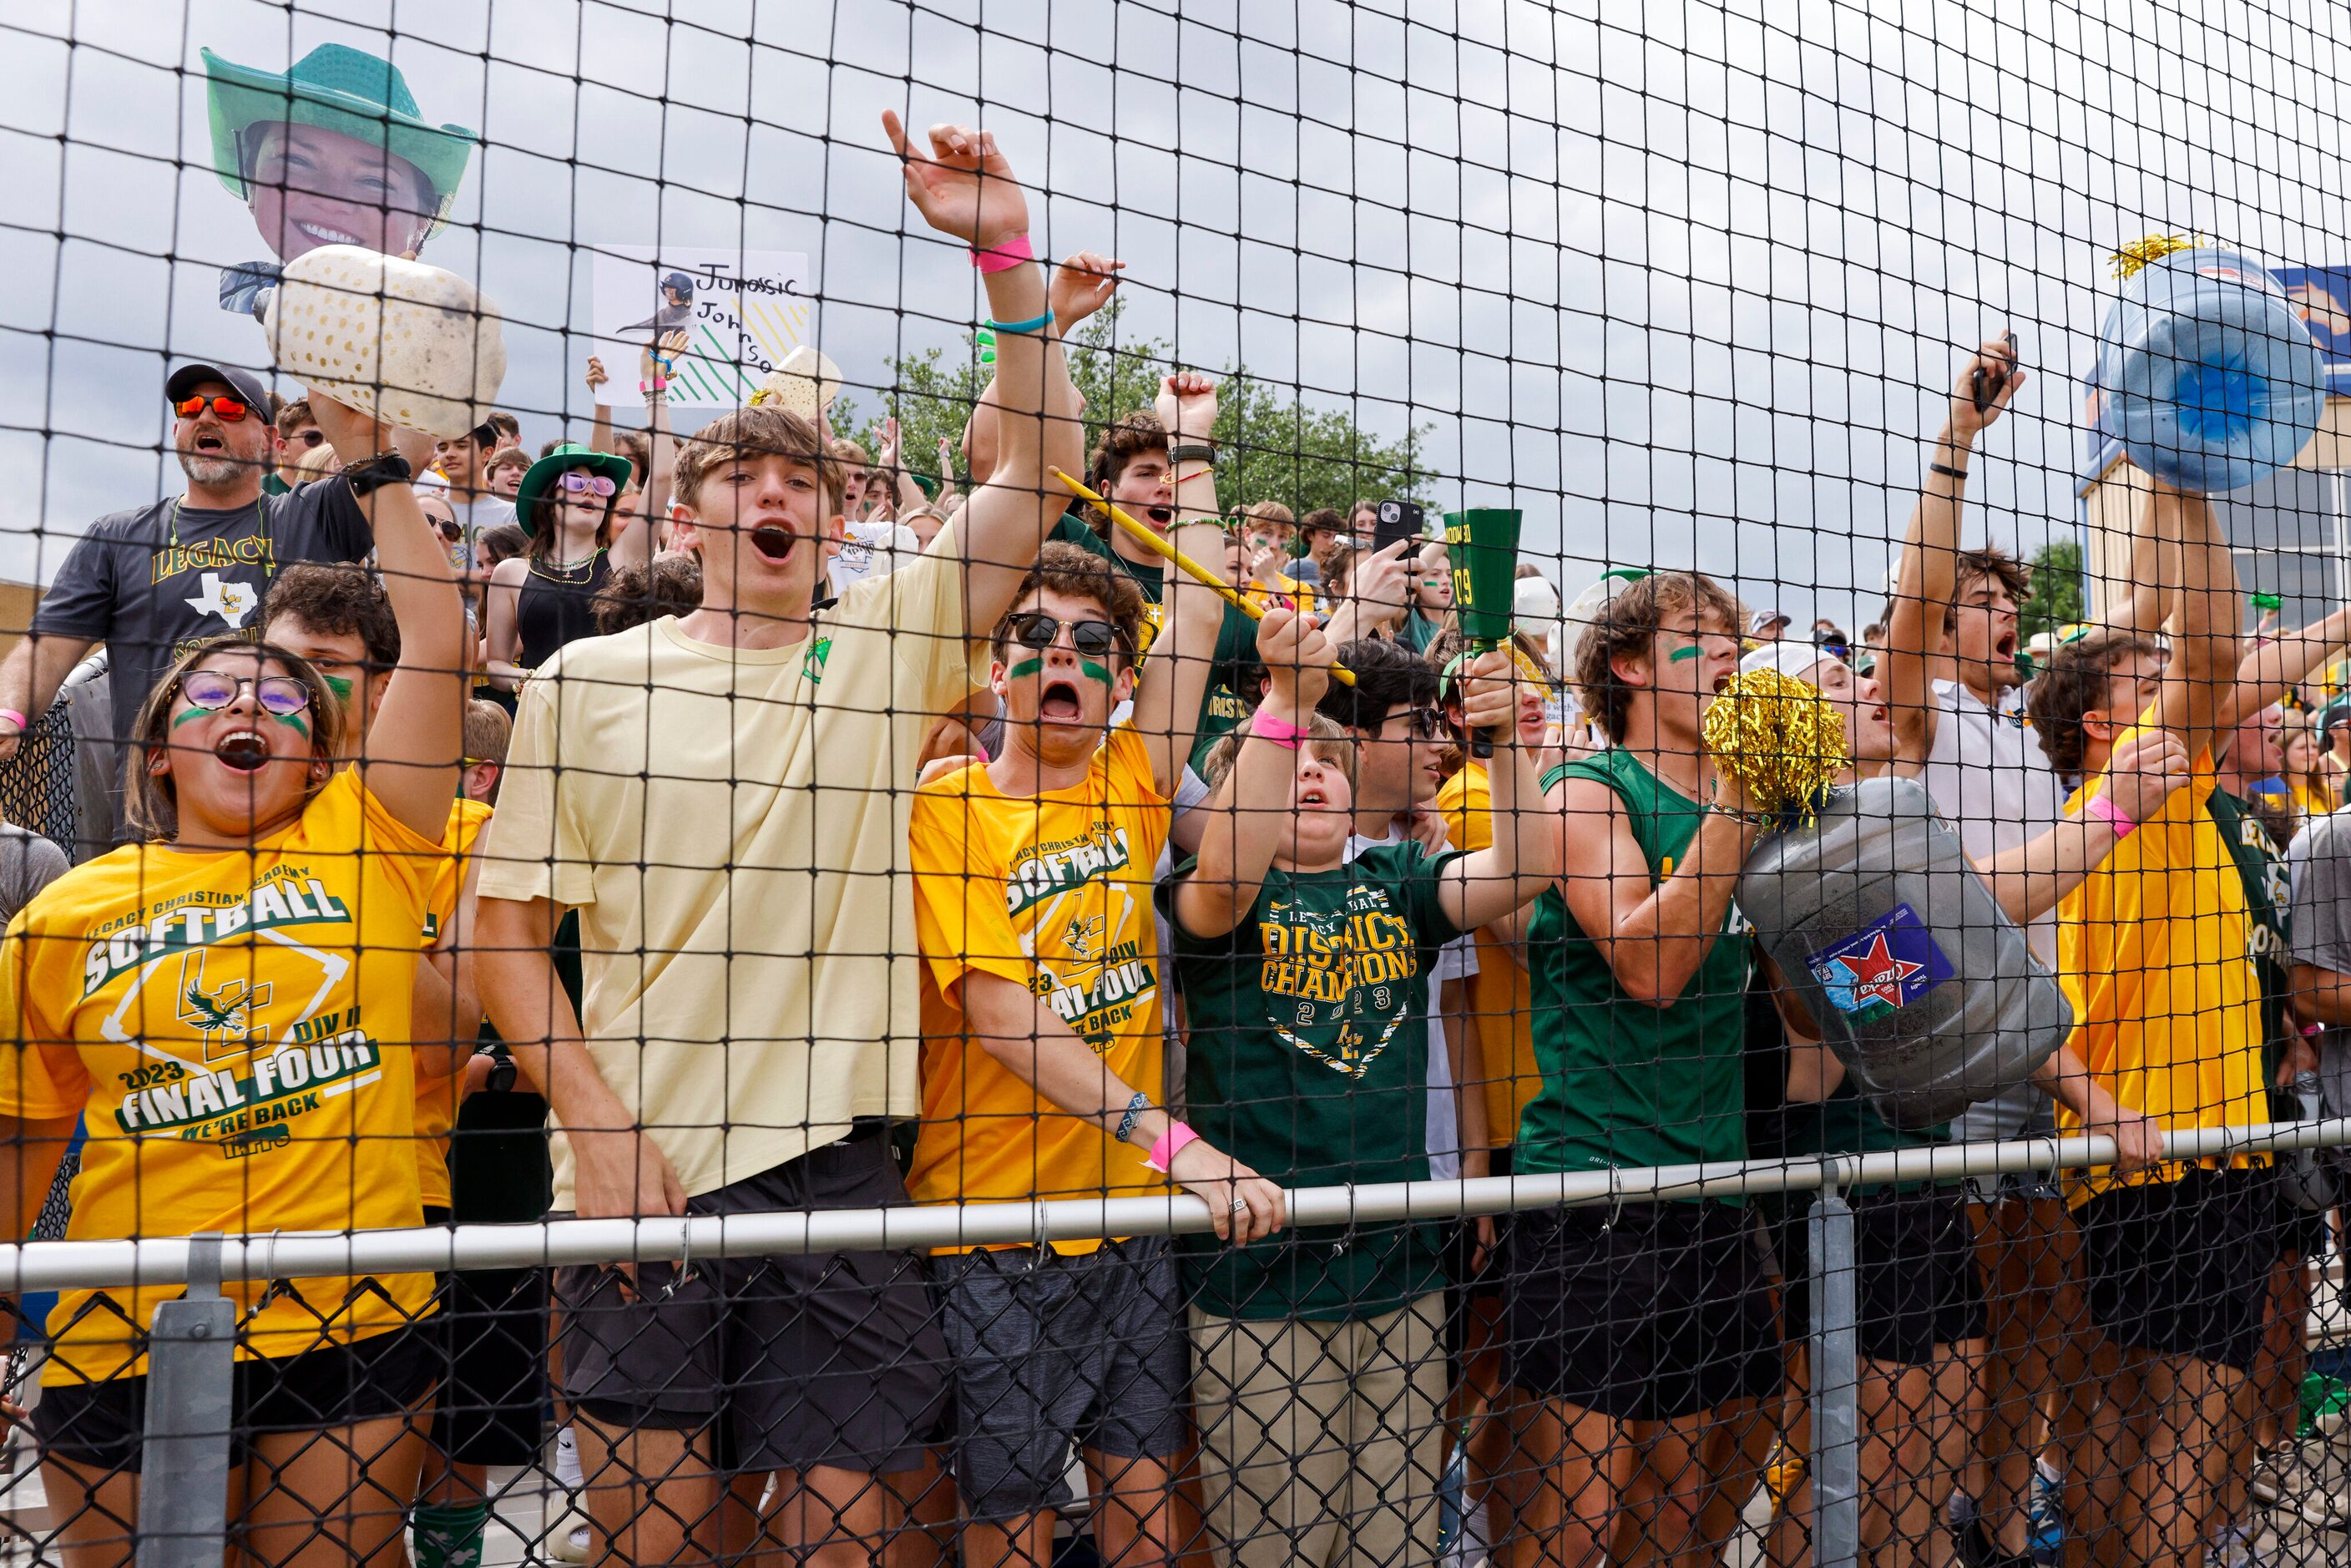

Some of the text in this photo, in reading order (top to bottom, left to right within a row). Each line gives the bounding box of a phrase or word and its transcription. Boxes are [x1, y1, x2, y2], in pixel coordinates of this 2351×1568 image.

[696, 301, 772, 374] Johnso
[151, 534, 276, 585] LEGACY
[153, 890, 245, 915] CHRISTIAN
[248, 863, 311, 888] CADEMY
[85, 878, 347, 994] SOFTBALL
[1860, 963, 1904, 996] Ozarka
[293, 1012, 340, 1044] DIV
[1088, 1004, 1133, 1032] BACK
[118, 1060, 185, 1090] 2023
[122, 1028, 372, 1128] FINAL FOUR
[254, 1090, 321, 1124] BACK
